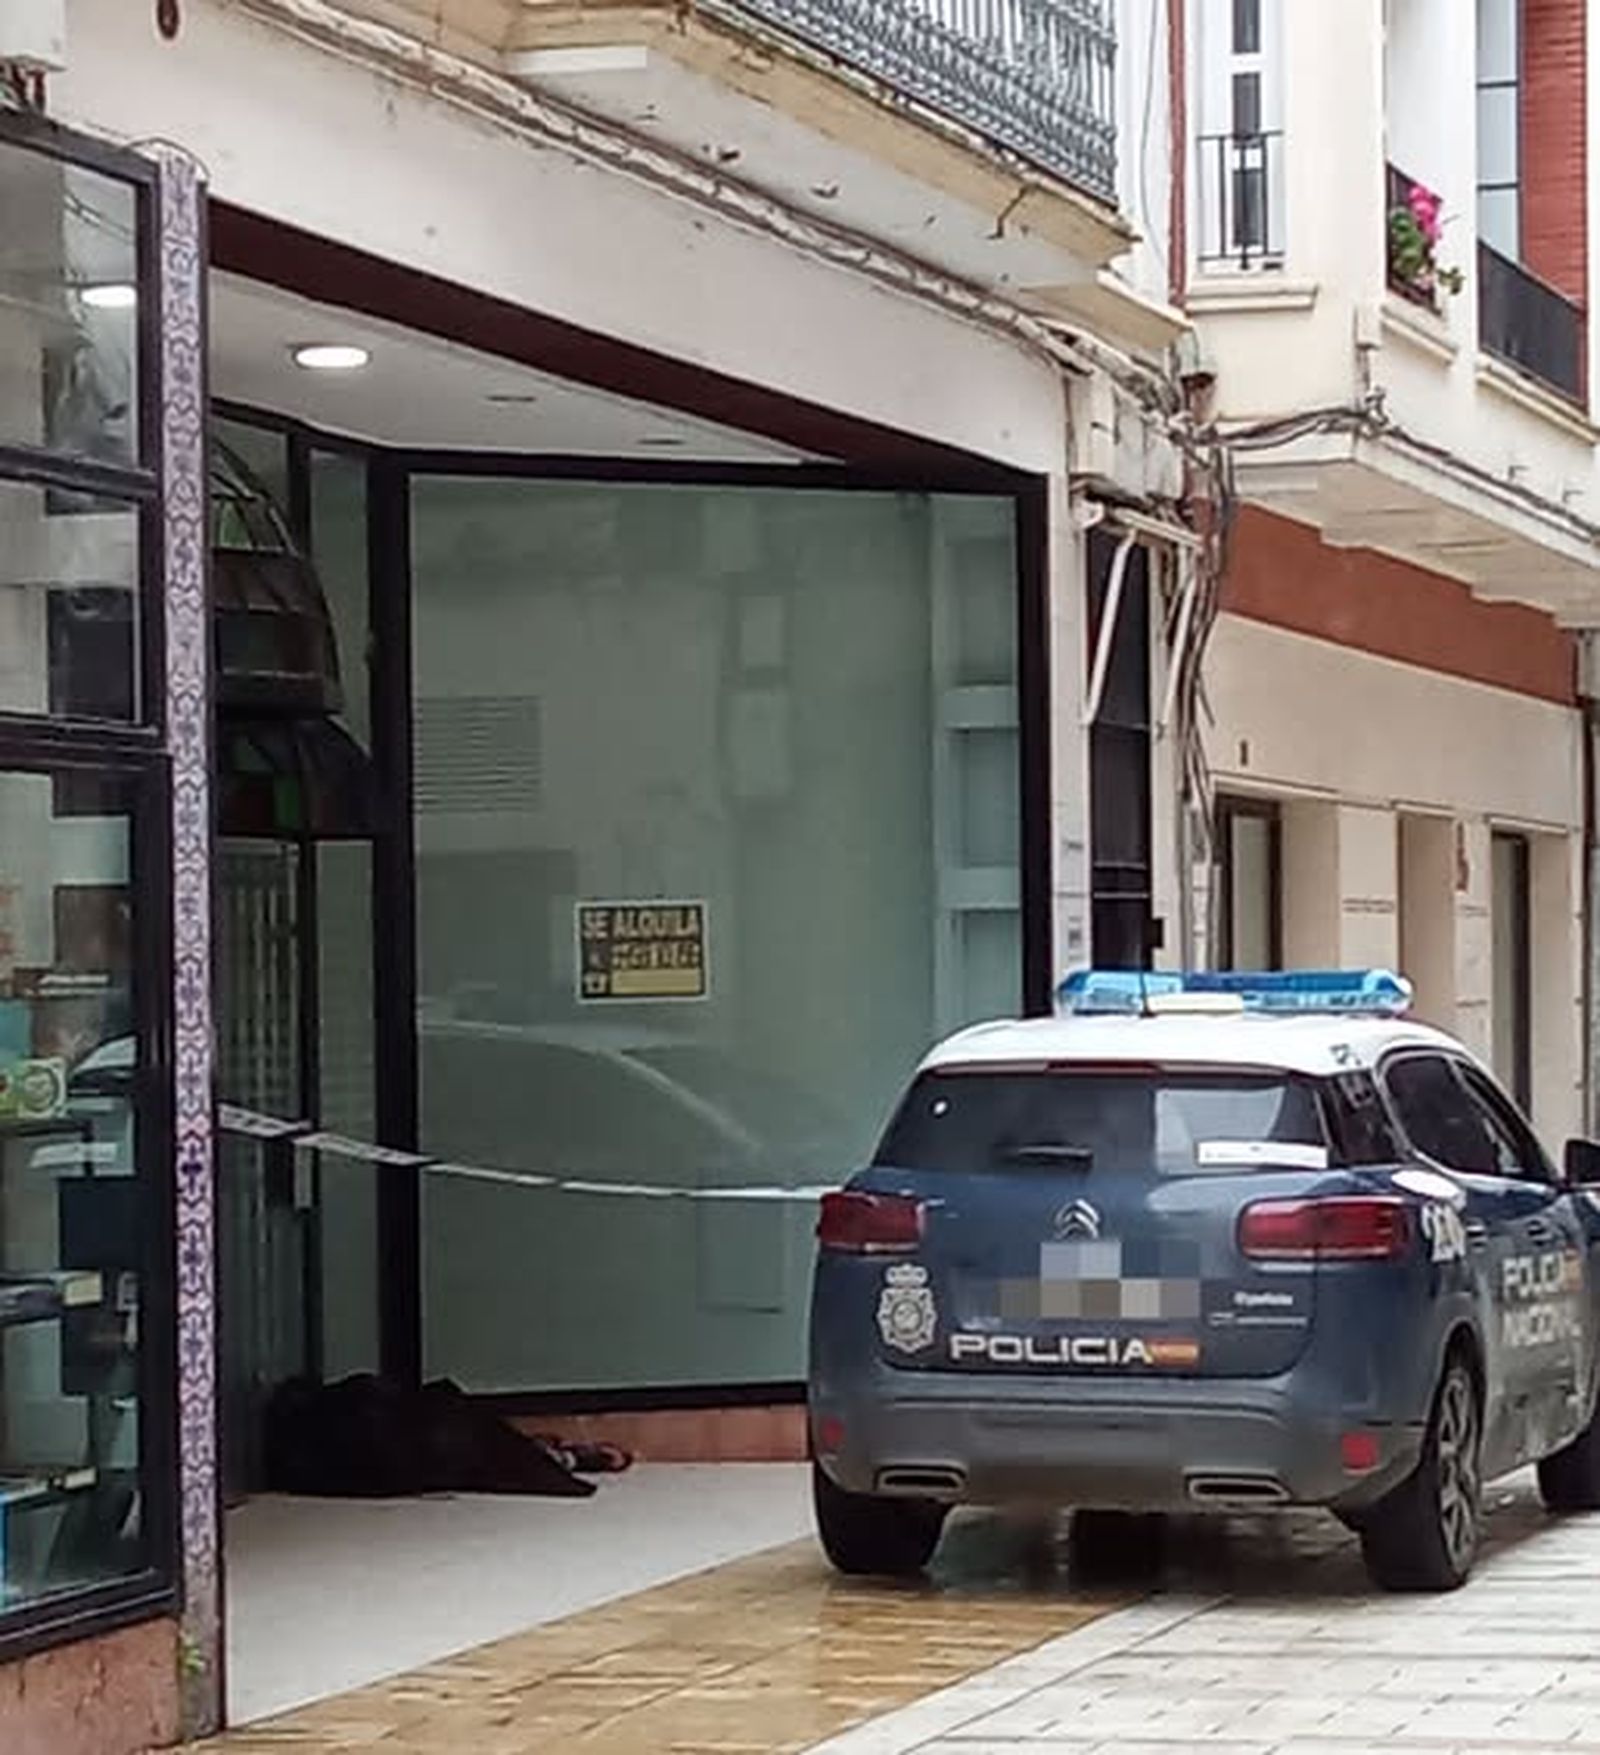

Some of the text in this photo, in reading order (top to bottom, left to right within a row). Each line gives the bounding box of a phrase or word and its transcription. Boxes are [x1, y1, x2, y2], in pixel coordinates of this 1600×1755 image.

[583, 908, 699, 938] SE ALQUILA
[951, 1334, 1154, 1364] POLICIA
